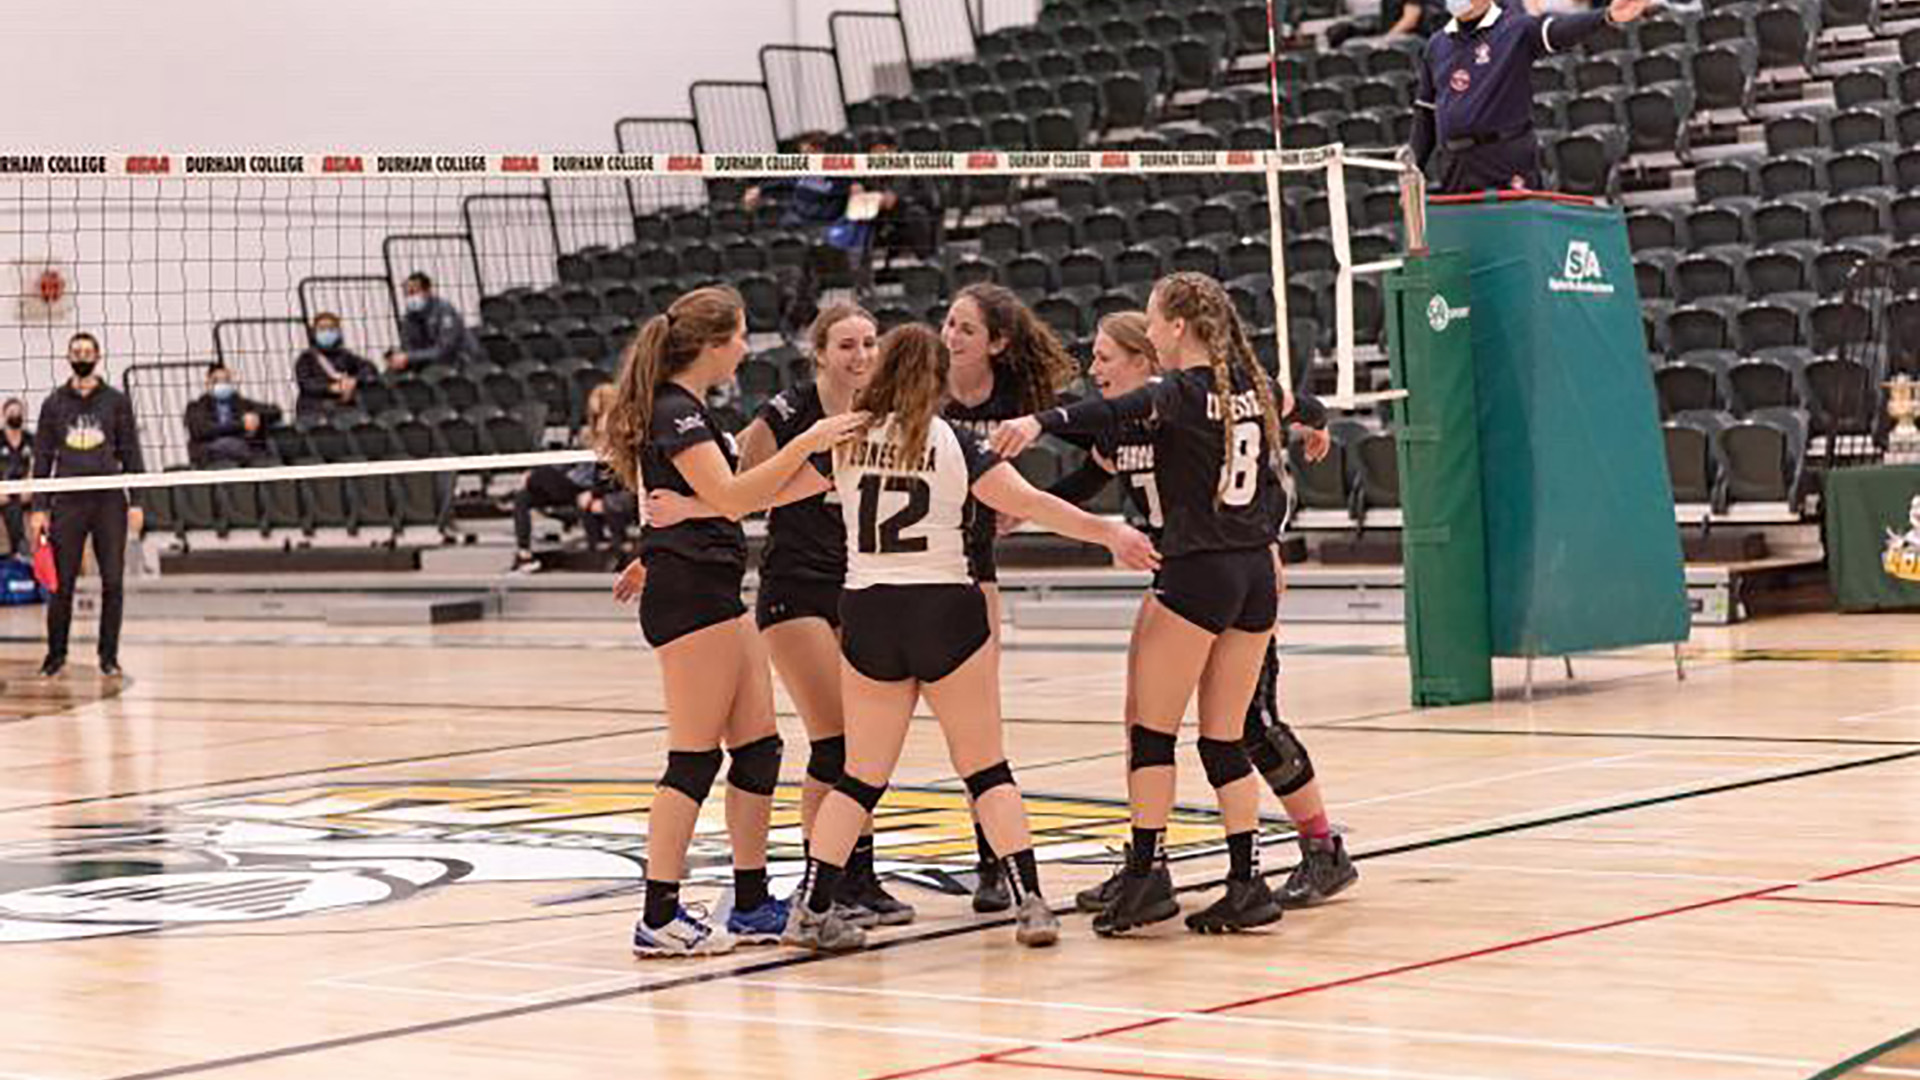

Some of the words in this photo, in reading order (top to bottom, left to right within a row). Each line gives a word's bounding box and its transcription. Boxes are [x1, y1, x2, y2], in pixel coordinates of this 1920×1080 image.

[48, 156, 105, 173] COLLEGE
[186, 156, 246, 172] DURHAM
[249, 156, 304, 172] COLLEGE
[377, 156, 432, 172] DURHAM
[435, 156, 486, 172] COLLEGE
[553, 156, 603, 171] DURHAM
[607, 156, 653, 171] COLLEGE
[715, 156, 763, 170] DURHAM
[766, 156, 809, 170] COLLEGE
[867, 156, 910, 169] DURHAM
[914, 155, 954, 169] COLLEGE
[1008, 154, 1049, 168] DURHAM
[1053, 154, 1091, 167] COLLEGE
[1219, 421, 1261, 505] 8
[857, 473, 930, 553] 12
[1131, 472, 1163, 528] 7
